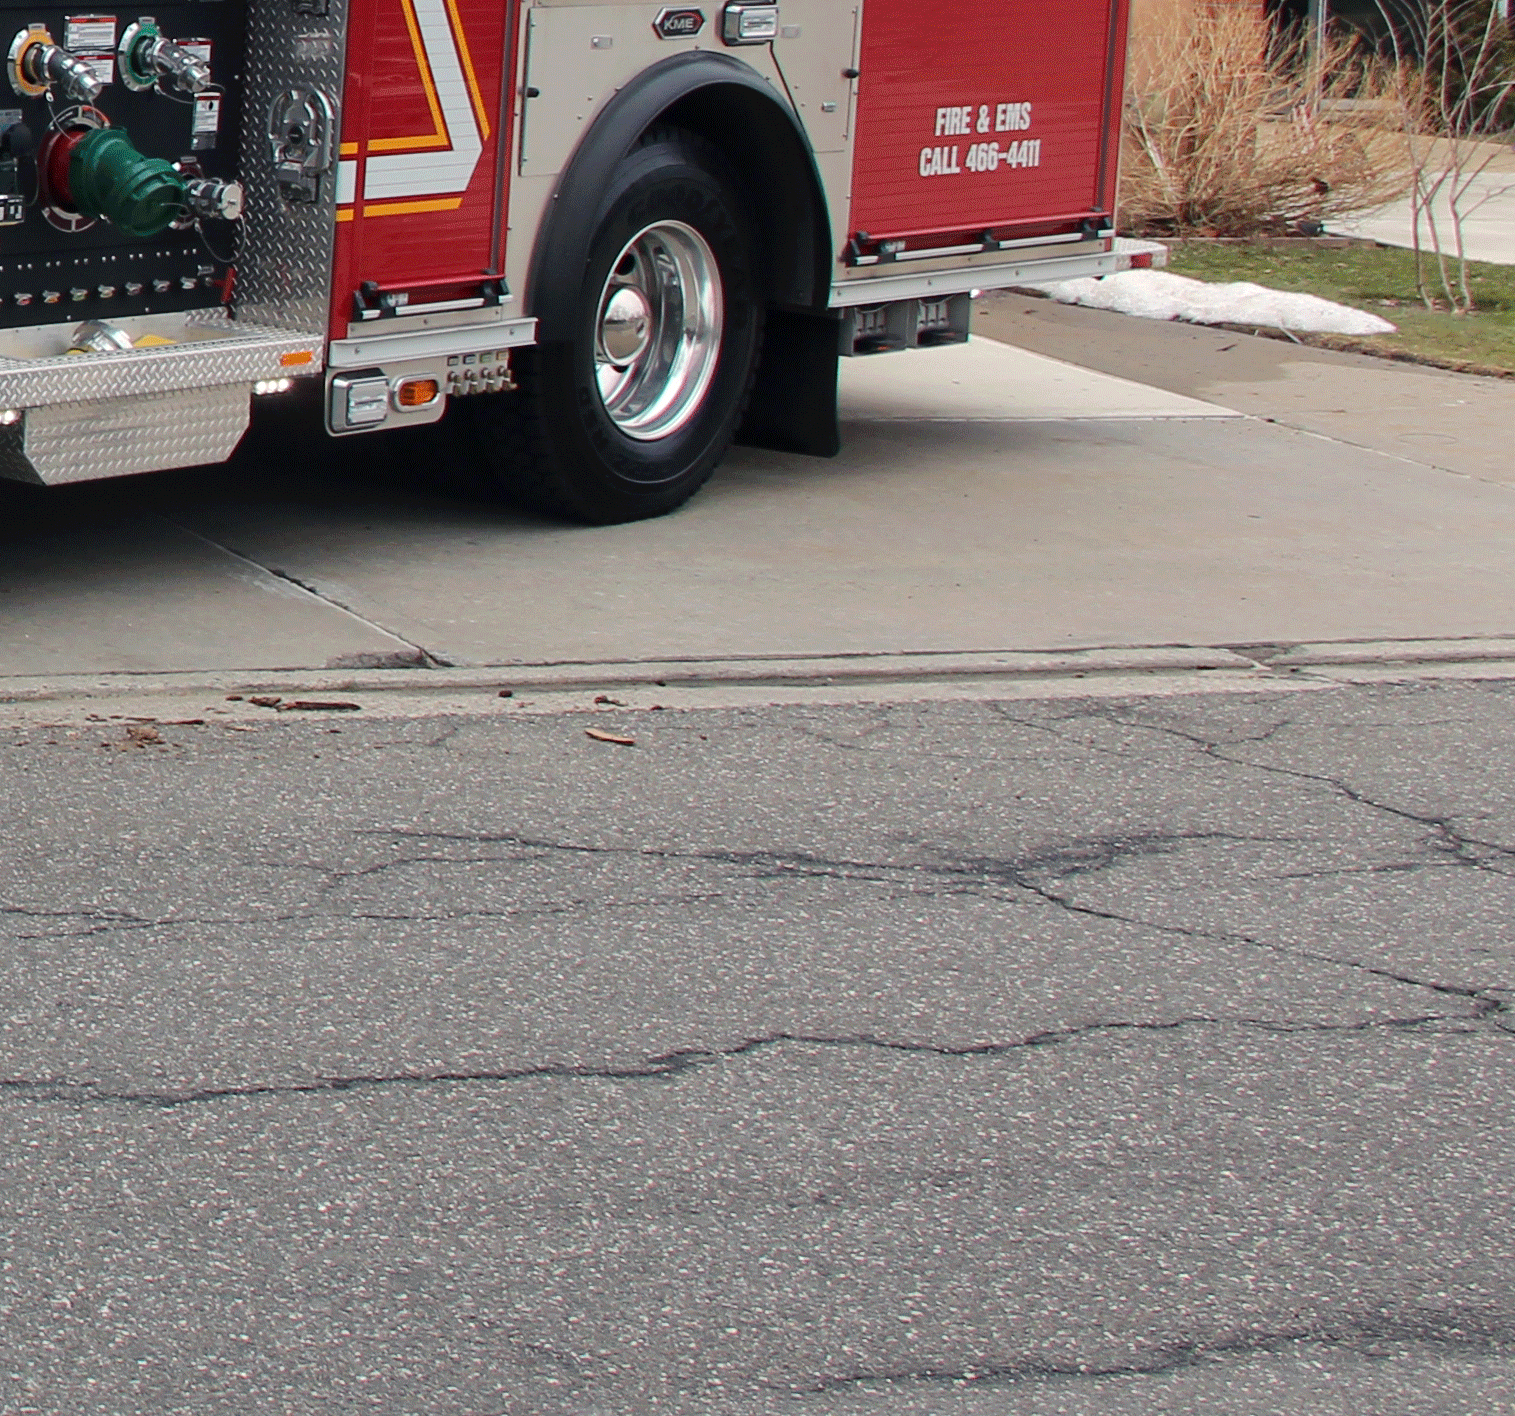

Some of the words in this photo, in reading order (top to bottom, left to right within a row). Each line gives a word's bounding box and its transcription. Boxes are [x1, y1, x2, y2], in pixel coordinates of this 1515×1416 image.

[663, 17, 694, 31] KME
[935, 105, 973, 136] FIRE
[975, 104, 991, 134] &
[994, 101, 1032, 133] EMS
[919, 145, 961, 178] CALL
[965, 139, 1041, 173] 466-4411
